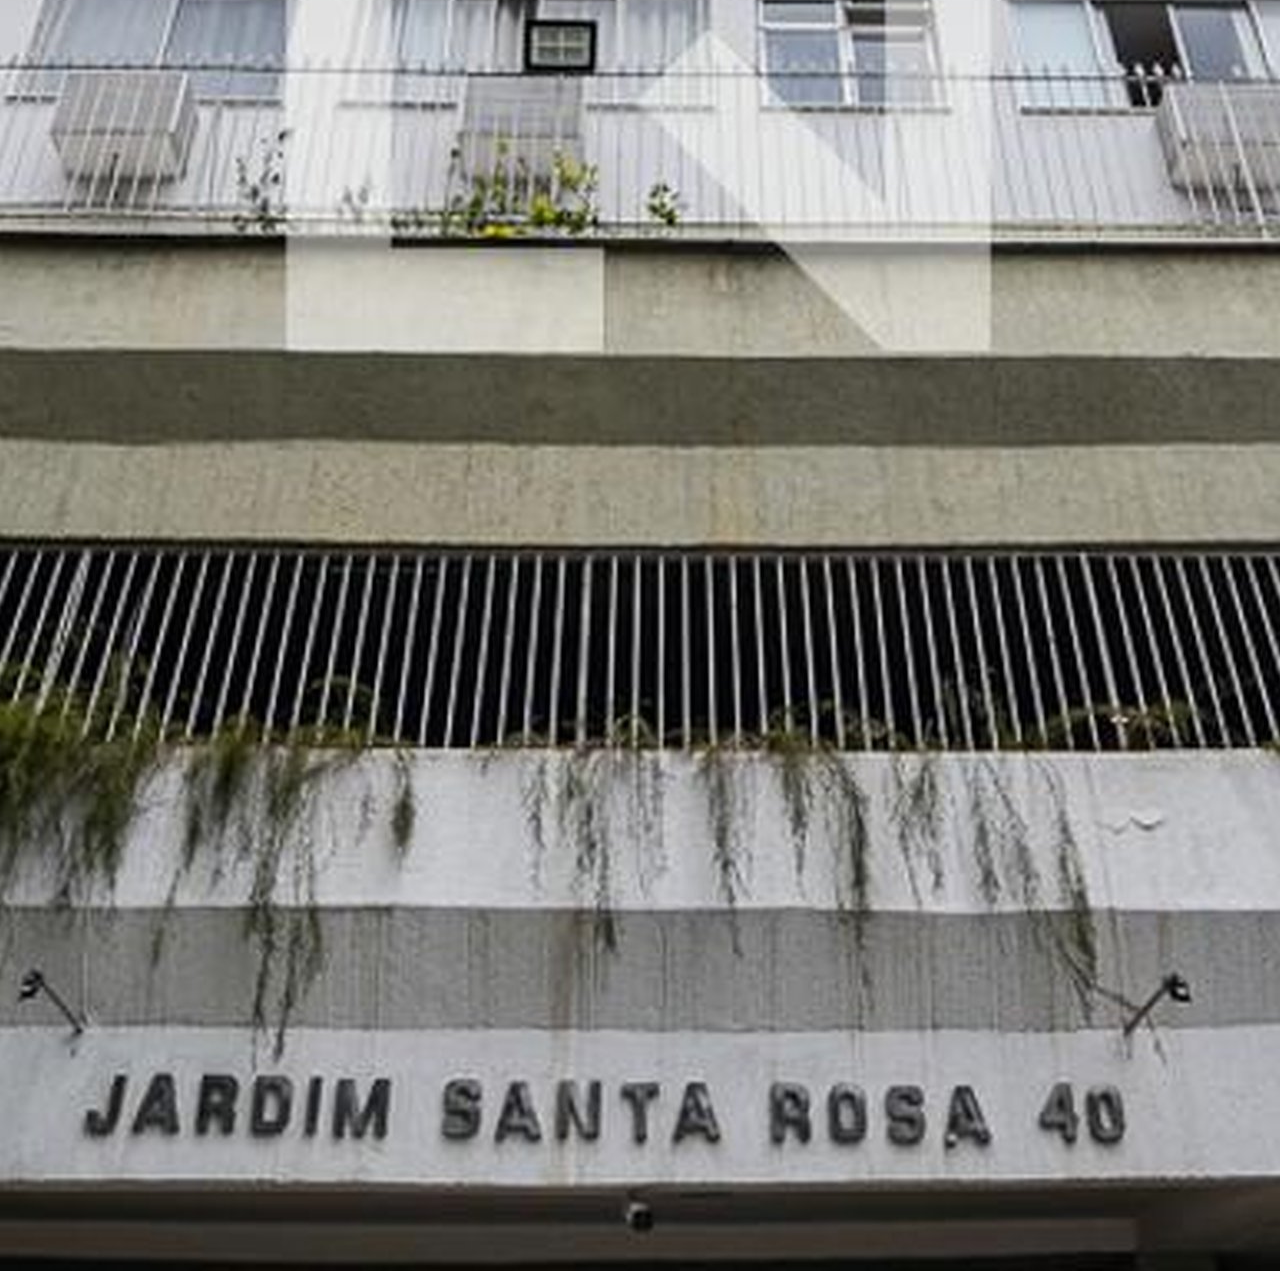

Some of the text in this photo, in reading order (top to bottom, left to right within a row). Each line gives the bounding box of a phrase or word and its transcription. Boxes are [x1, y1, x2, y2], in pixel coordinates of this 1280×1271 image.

[83, 1073, 1126, 1149] JARDIM SANTA ROSA 40
